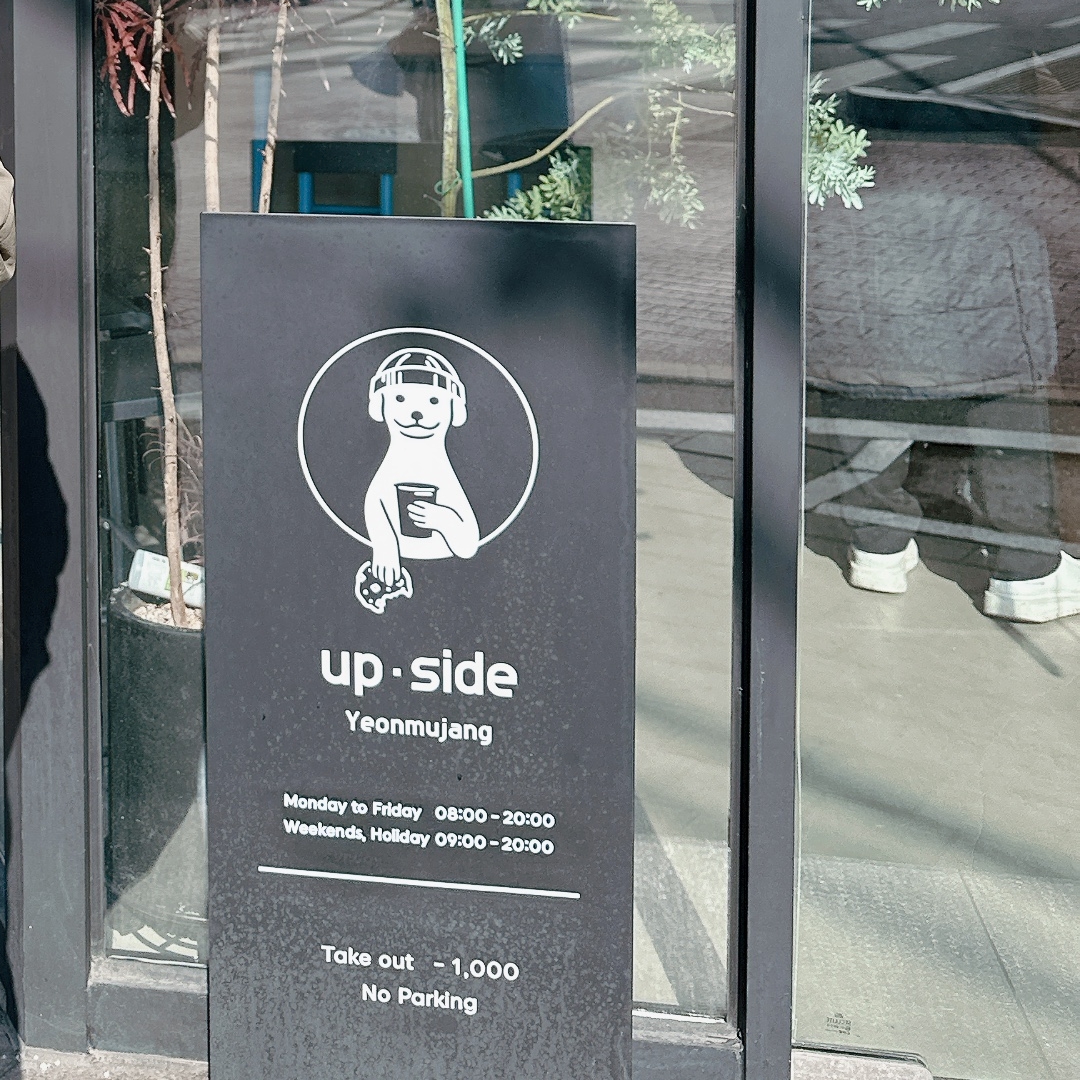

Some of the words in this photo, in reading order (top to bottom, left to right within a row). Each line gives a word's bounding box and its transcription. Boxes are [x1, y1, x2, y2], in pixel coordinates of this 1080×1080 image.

[345, 709, 493, 746] Yeonmujang
[283, 792, 348, 816] Monday
[351, 800, 369, 815] to
[372, 801, 423, 821] Friday
[283, 818, 367, 843] Weekends,
[370, 826, 431, 848] Holiday
[321, 944, 372, 967] Take
[378, 953, 415, 971] out
[361, 983, 391, 1004] No
[398, 986, 478, 1016] Parking
